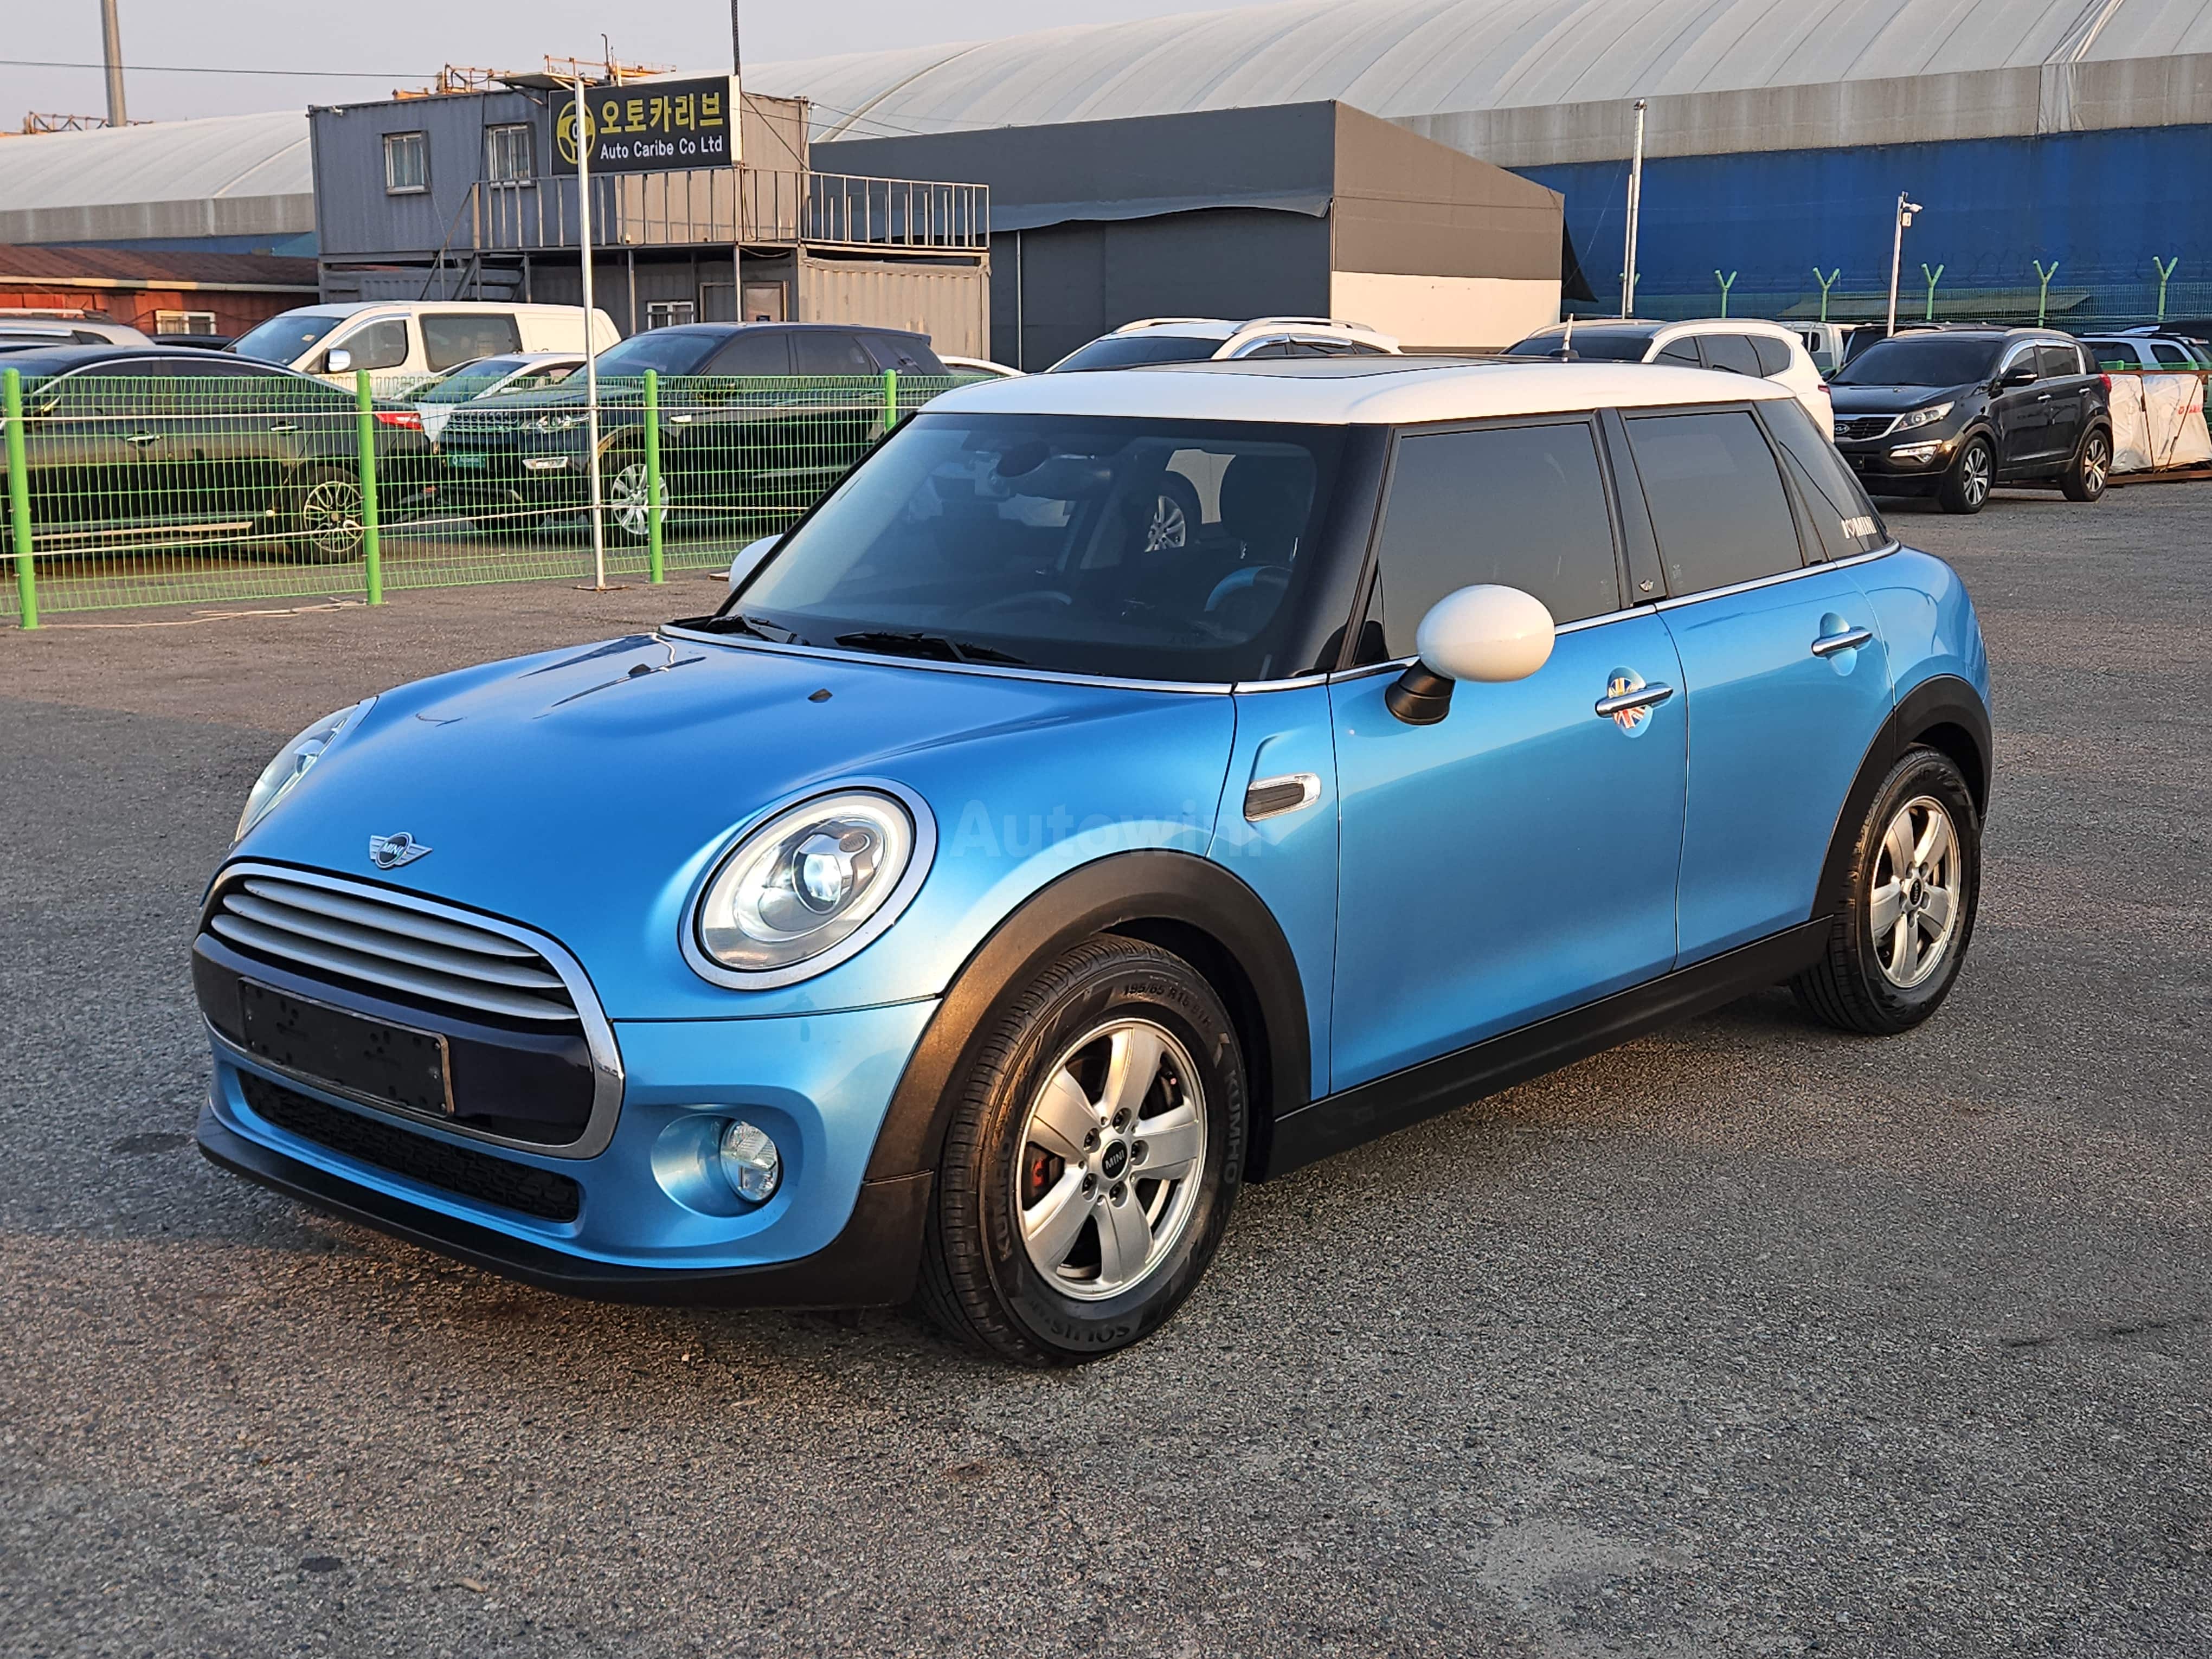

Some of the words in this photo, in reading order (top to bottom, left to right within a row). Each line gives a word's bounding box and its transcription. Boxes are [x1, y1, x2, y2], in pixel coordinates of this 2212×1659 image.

[600, 92, 723, 134] 오토카리브
[600, 143, 628, 159] Auto
[633, 139, 674, 158] Caribe
[679, 138, 696, 155] Co
[700, 135, 723, 152] Ltd
[383, 842, 404, 856] MINI
[1224, 1069, 1242, 1185] KUMHO
[1105, 1149, 1125, 1170] MINI
